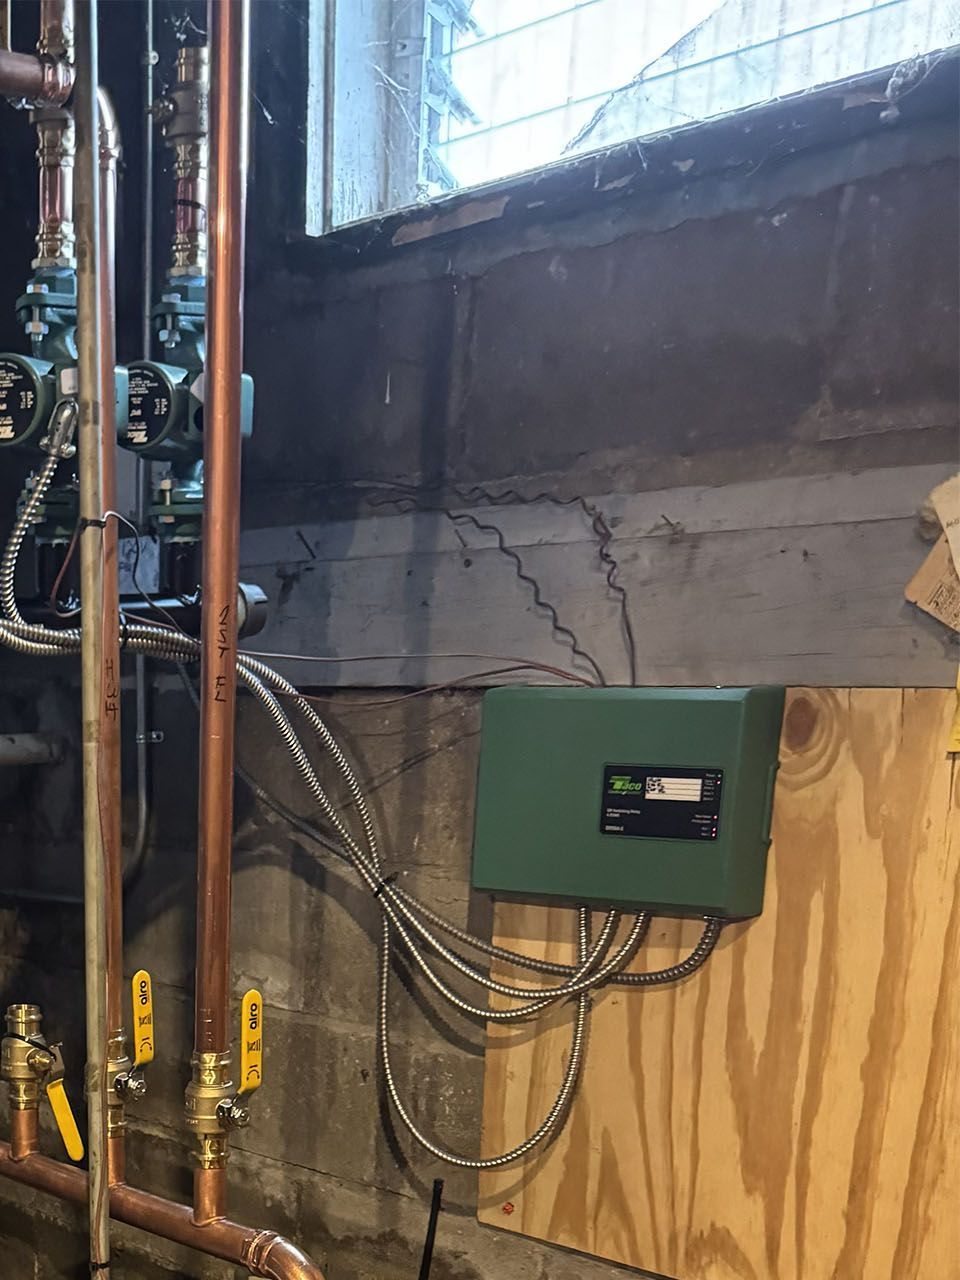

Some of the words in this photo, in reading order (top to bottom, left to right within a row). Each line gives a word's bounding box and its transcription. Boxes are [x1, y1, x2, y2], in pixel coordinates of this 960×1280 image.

[609, 776, 642, 791] Taco
[139, 980, 147, 1005] alro
[249, 1003, 258, 1030] alro
